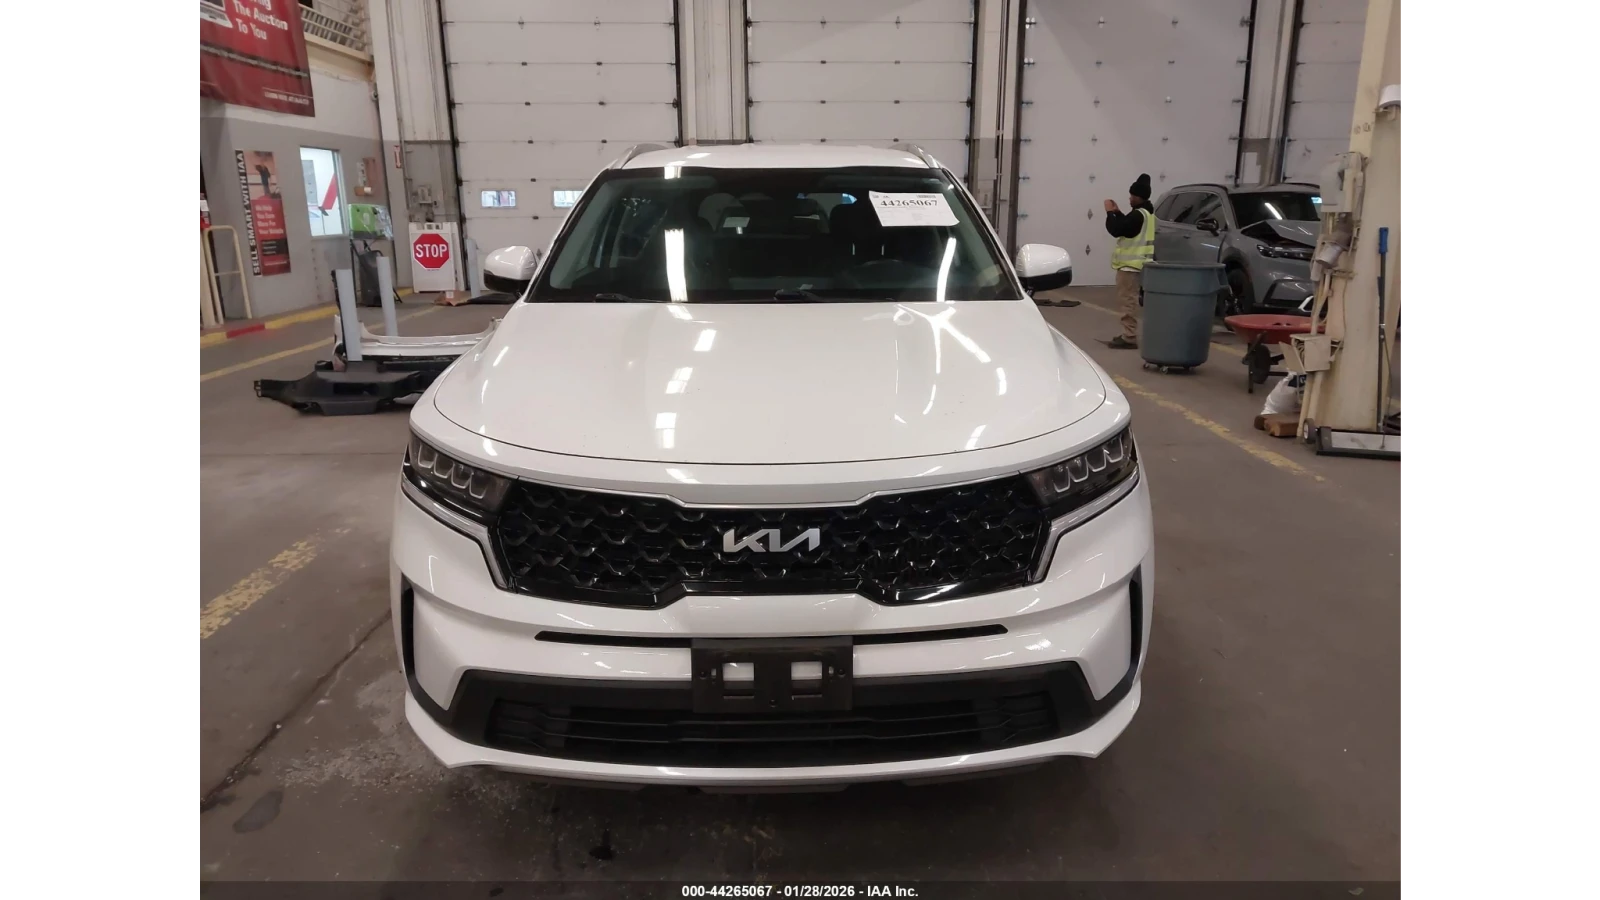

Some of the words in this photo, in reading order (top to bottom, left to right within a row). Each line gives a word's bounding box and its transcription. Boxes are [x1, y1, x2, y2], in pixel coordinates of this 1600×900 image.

[233, 0, 252, 17] The
[253, 7, 288, 30] Auction
[235, 18, 248, 34] To
[250, 22, 267, 40] You
[237, 153, 245, 173] IAA
[240, 175, 249, 205] WITH
[244, 209, 256, 246] SMART
[416, 244, 447, 257] STOP
[251, 251, 260, 274] SELL
[723, 528, 820, 552] KIA
